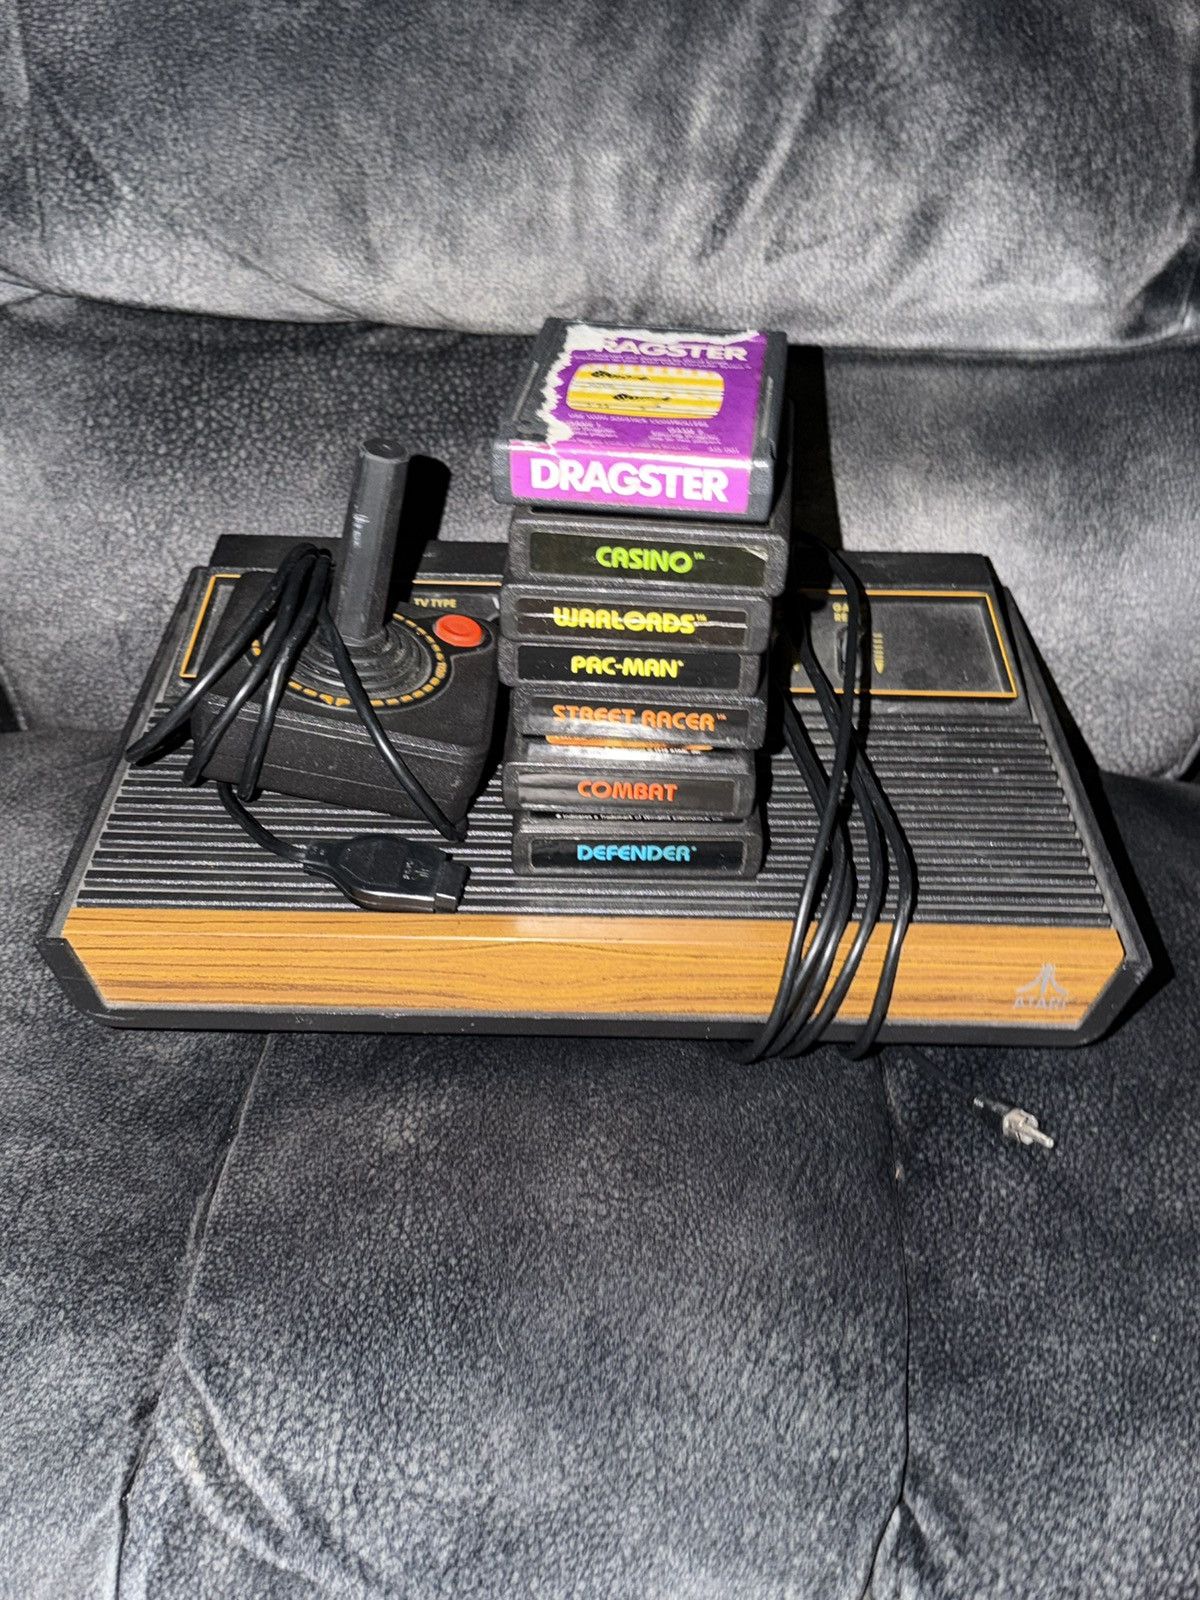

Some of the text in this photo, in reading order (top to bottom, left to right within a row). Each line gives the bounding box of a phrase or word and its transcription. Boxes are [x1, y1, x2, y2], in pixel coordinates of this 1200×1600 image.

[599, 338, 749, 361] RAGSTER
[529, 458, 729, 502] DRAGSTER
[595, 546, 693, 573] CASINO
[413, 597, 457, 609] TV TYPE
[553, 606, 696, 634] WARLORDS
[570, 655, 679, 679] PAC-MAN
[552, 704, 715, 732] STREET RACER
[577, 779, 678, 801] COMBAT
[577, 844, 691, 862] DEFENDER
